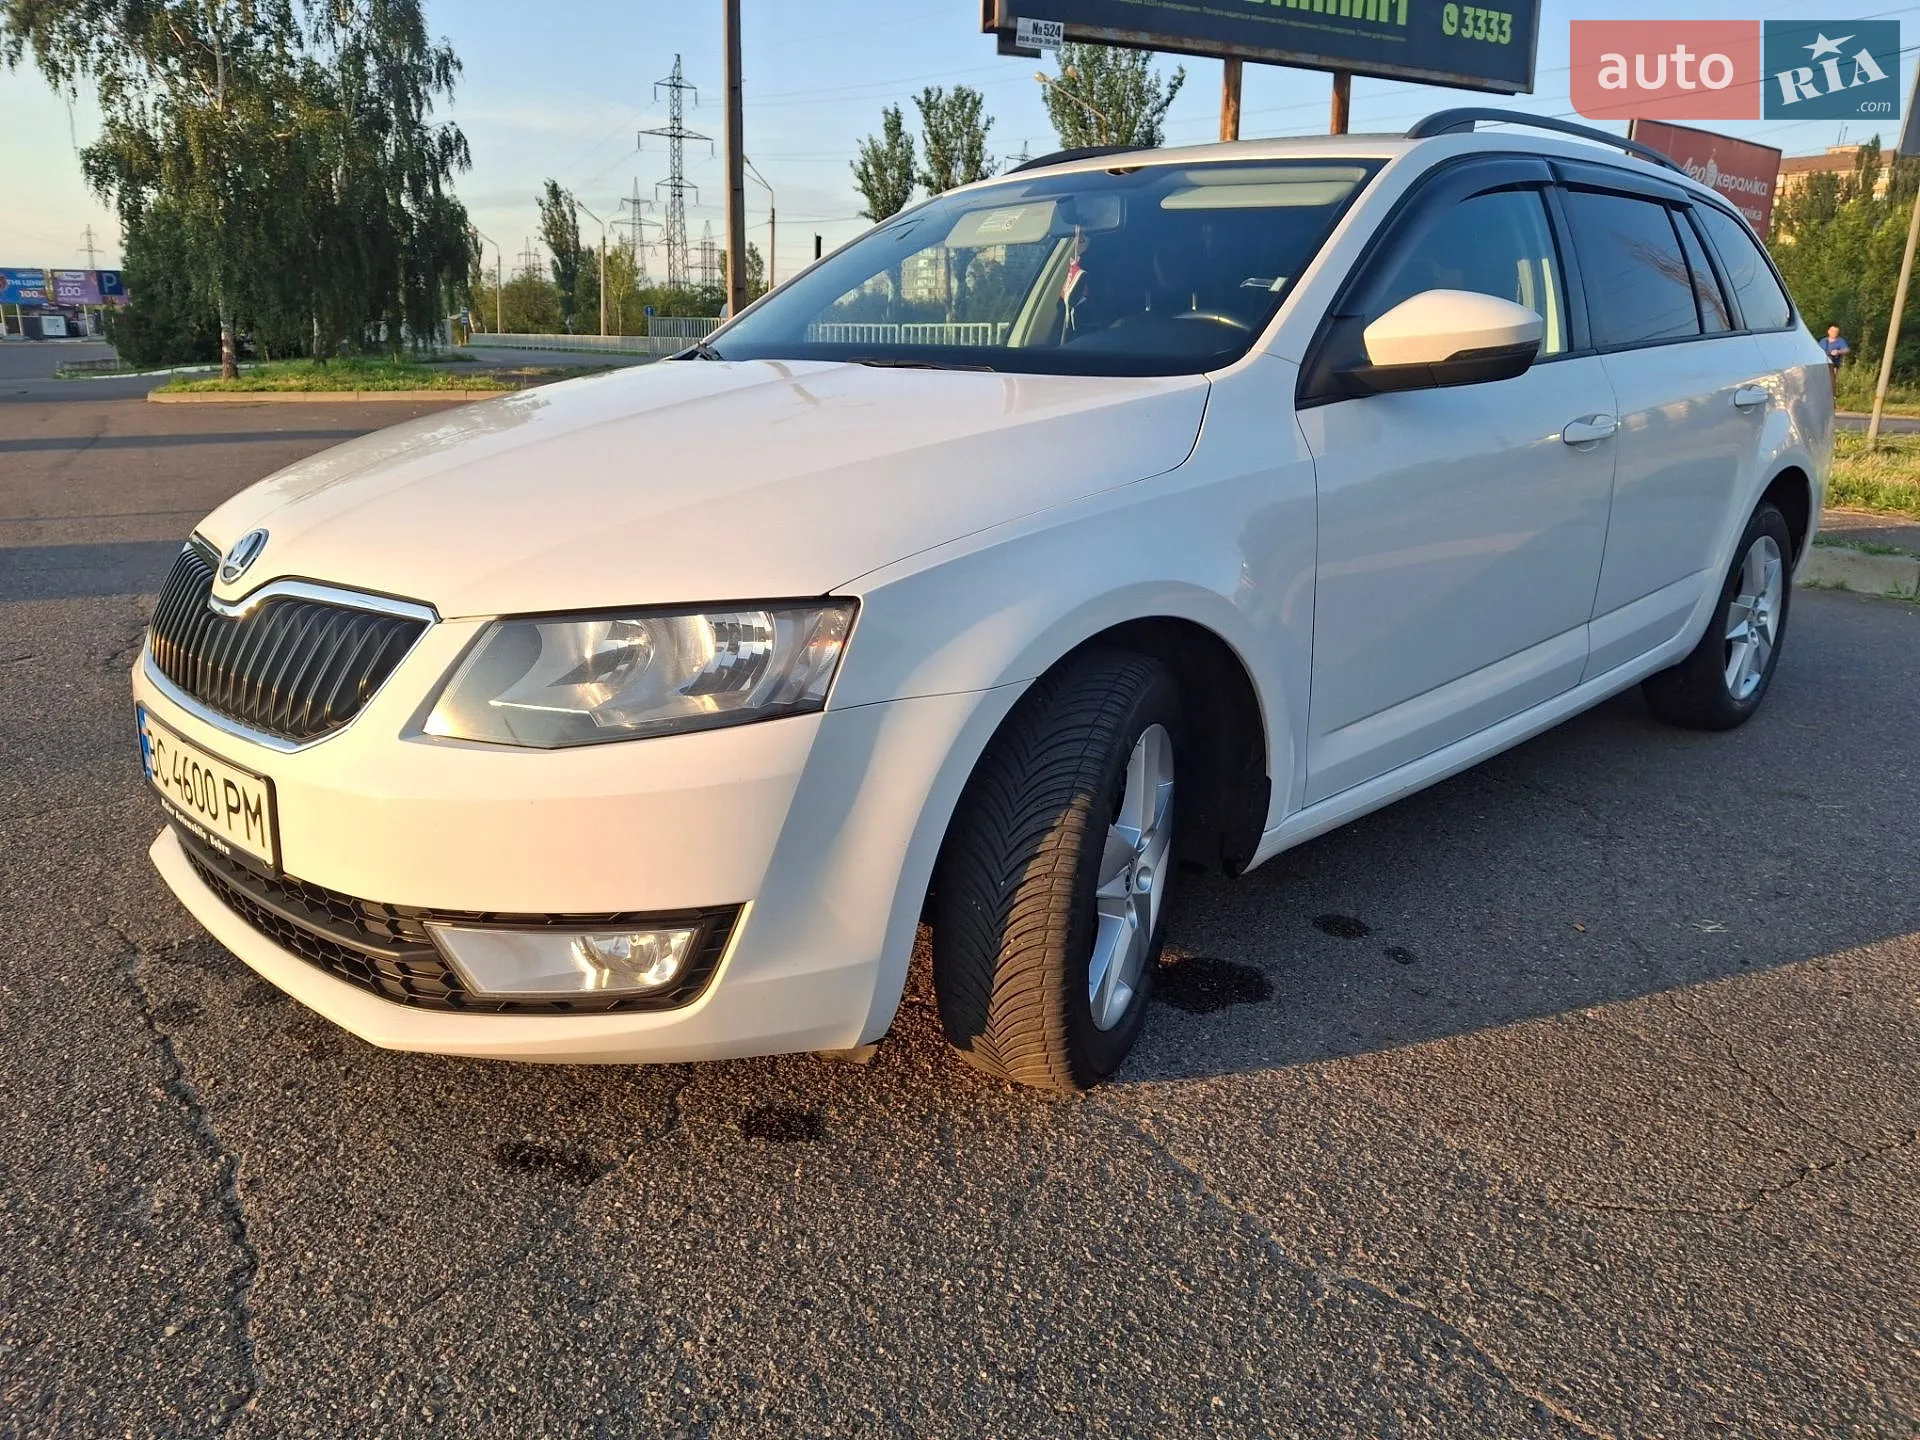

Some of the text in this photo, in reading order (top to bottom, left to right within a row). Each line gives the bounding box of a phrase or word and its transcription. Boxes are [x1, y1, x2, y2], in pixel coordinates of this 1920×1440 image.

[1461, 5, 1512, 45] 3333
[172, 750, 219, 822] 4600
[222, 777, 266, 848] PM
